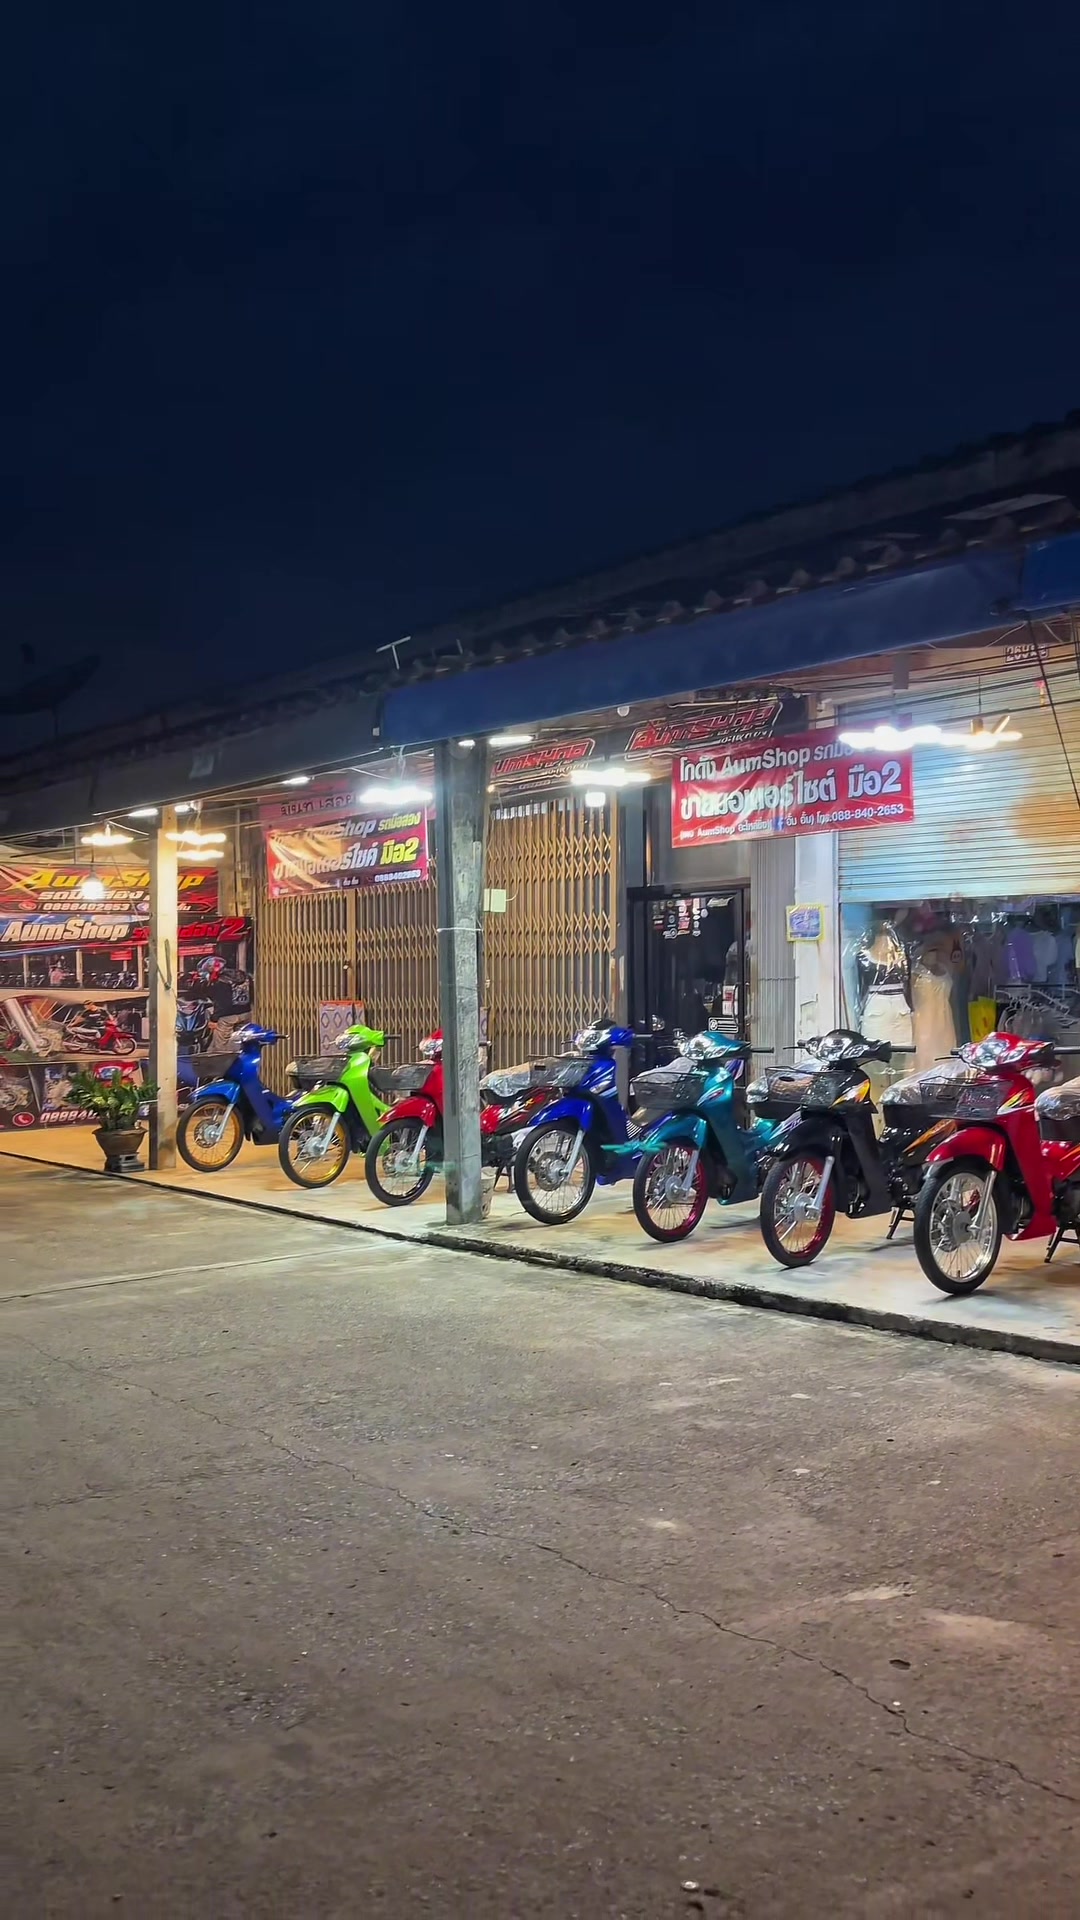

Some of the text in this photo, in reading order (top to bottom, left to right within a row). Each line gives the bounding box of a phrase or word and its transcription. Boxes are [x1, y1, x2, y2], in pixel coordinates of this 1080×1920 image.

[721, 747, 810, 777] AumShop
[848, 761, 902, 798] มือ2
[379, 837, 420, 865] มือ2
[1, 917, 130, 942] AumShop
